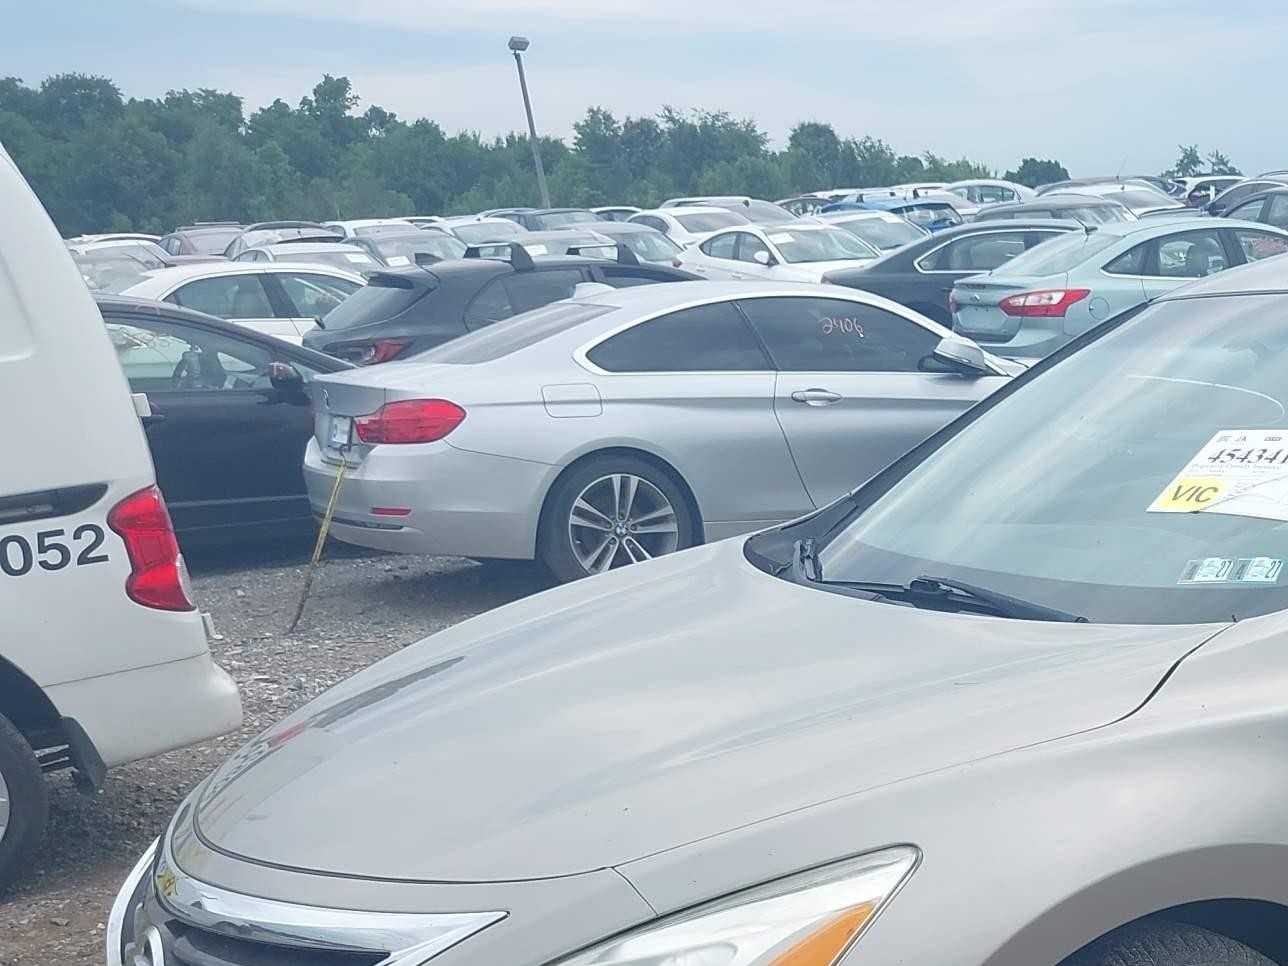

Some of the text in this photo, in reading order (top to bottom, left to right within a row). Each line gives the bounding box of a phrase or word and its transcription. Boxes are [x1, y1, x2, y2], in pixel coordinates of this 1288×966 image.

[819, 317, 864, 337] 2406
[1172, 485, 1218, 502] VIC
[0, 524, 109, 576] 052
[1215, 560, 1232, 577] 27
[1265, 560, 1283, 578] 27
